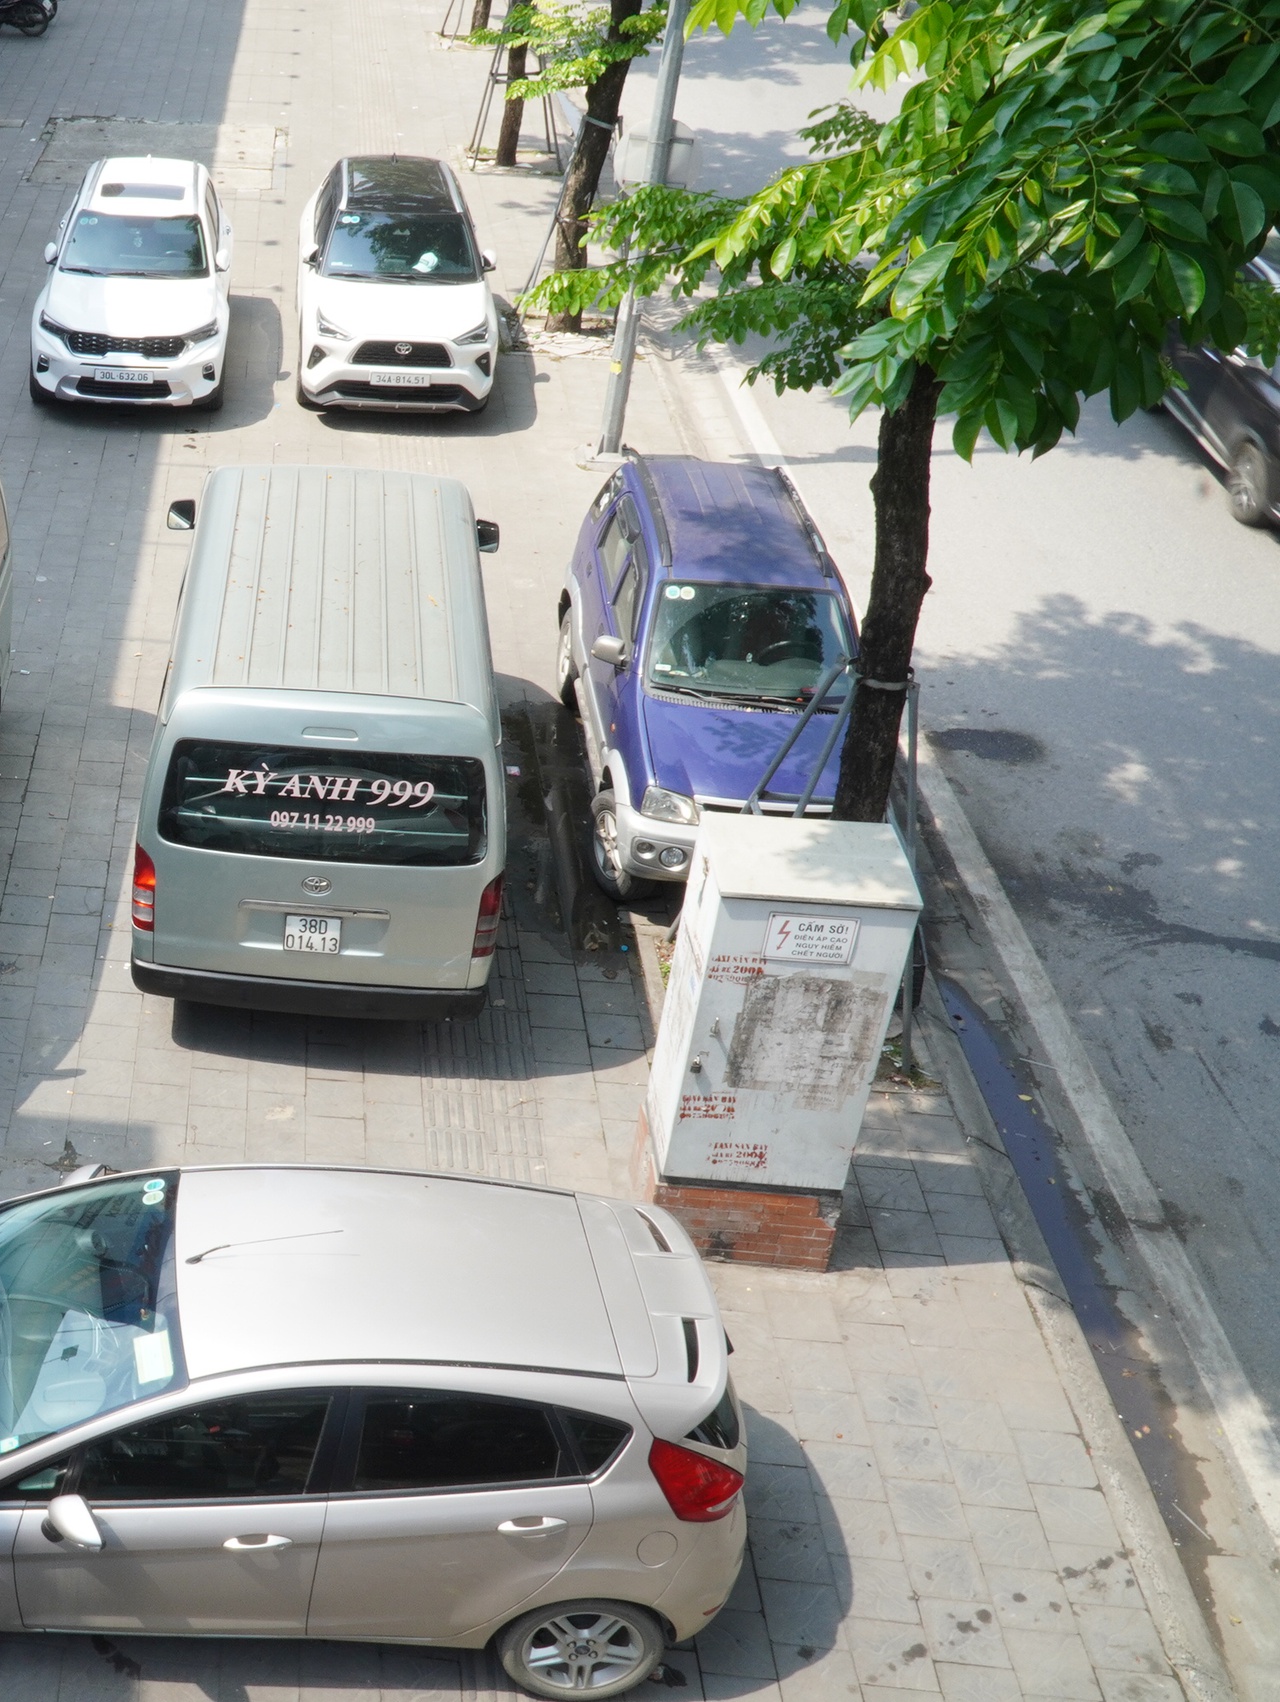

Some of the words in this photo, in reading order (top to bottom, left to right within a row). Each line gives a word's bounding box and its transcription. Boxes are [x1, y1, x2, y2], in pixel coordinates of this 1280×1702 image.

[222, 762, 278, 795] KỲ
[278, 774, 362, 801] ANH
[366, 779, 435, 809] 999
[270, 811, 299, 828] 097
[303, 813, 319, 830] 11
[324, 815, 342, 831] 22
[346, 816, 375, 834] 999
[299, 918, 328, 934] 38D
[798, 921, 824, 933] CẤM
[286, 934, 338, 952] 014.13
